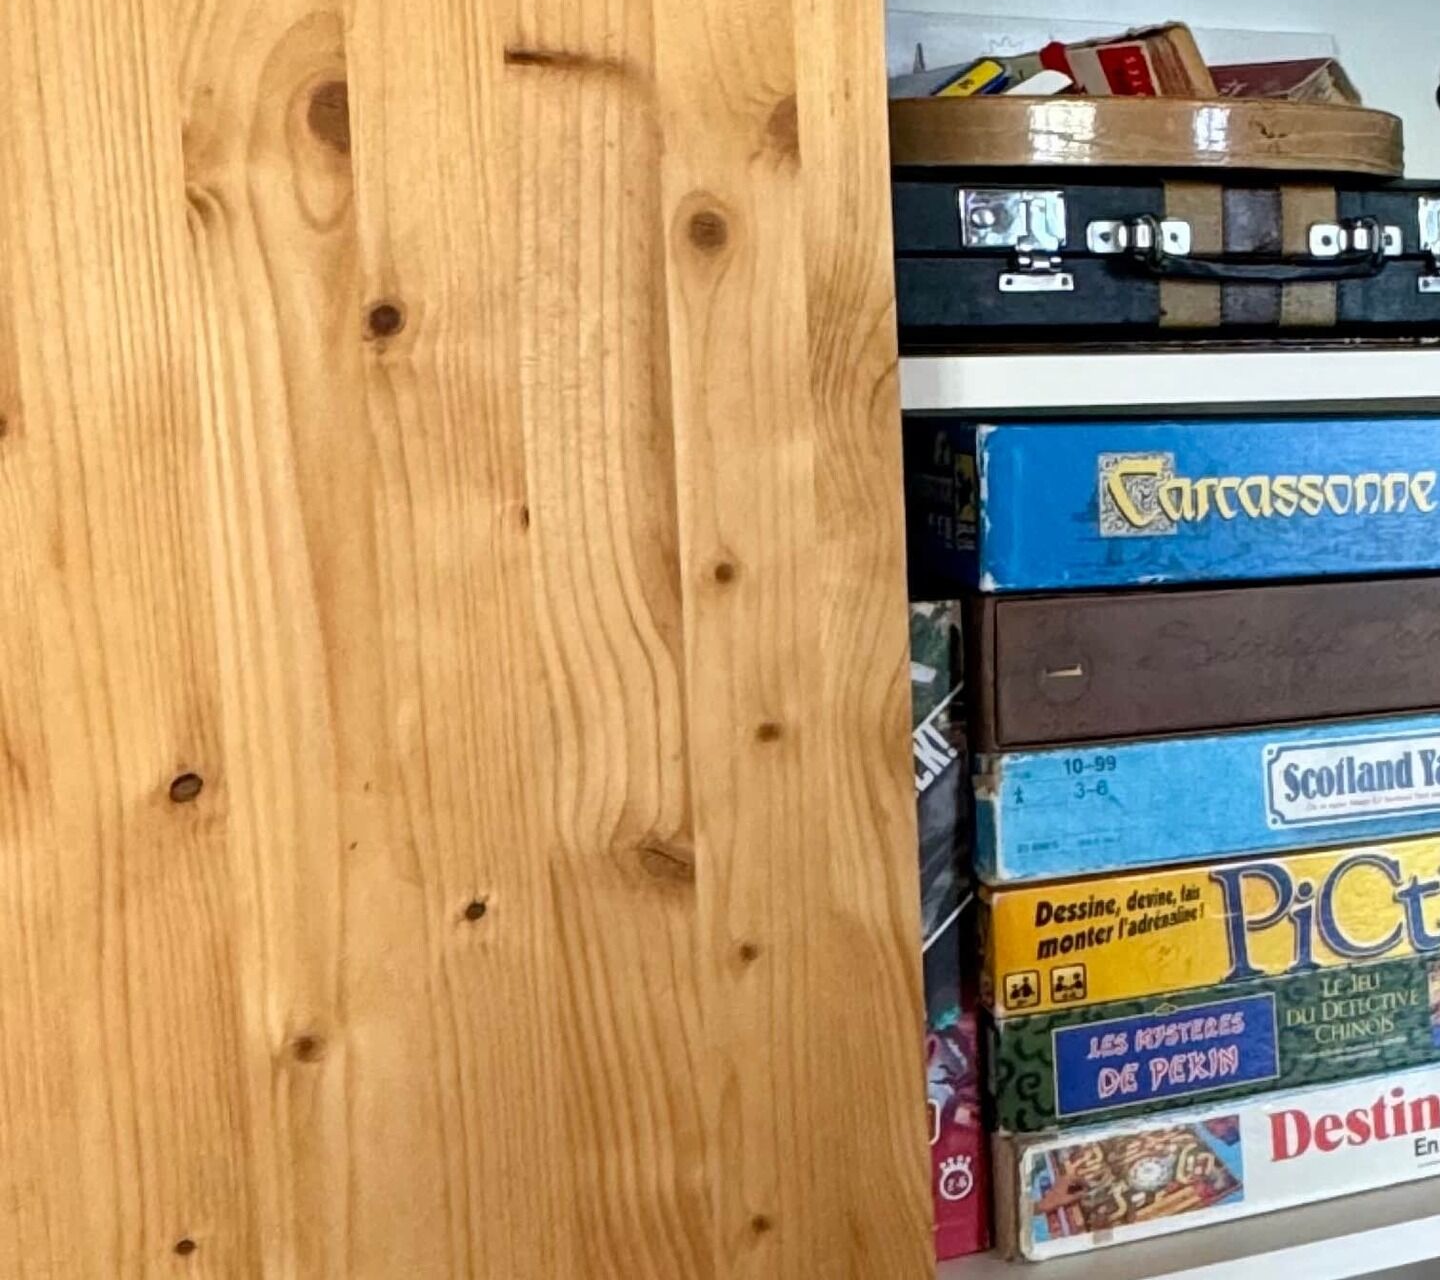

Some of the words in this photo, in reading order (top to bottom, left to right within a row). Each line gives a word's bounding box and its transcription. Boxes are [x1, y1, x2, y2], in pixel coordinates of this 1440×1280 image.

[1104, 458, 1439, 528] Carcassonne
[1282, 751, 1415, 803] Scotland
[1035, 894, 1121, 928] Dessine,
[1126, 887, 1177, 912] devine,
[1037, 924, 1114, 961] monter
[1087, 1031, 1129, 1060] LES
[1314, 1014, 1395, 1044] CHINOIS
[1097, 1061, 1140, 1100] DE
[1414, 1136, 1440, 1157] En
